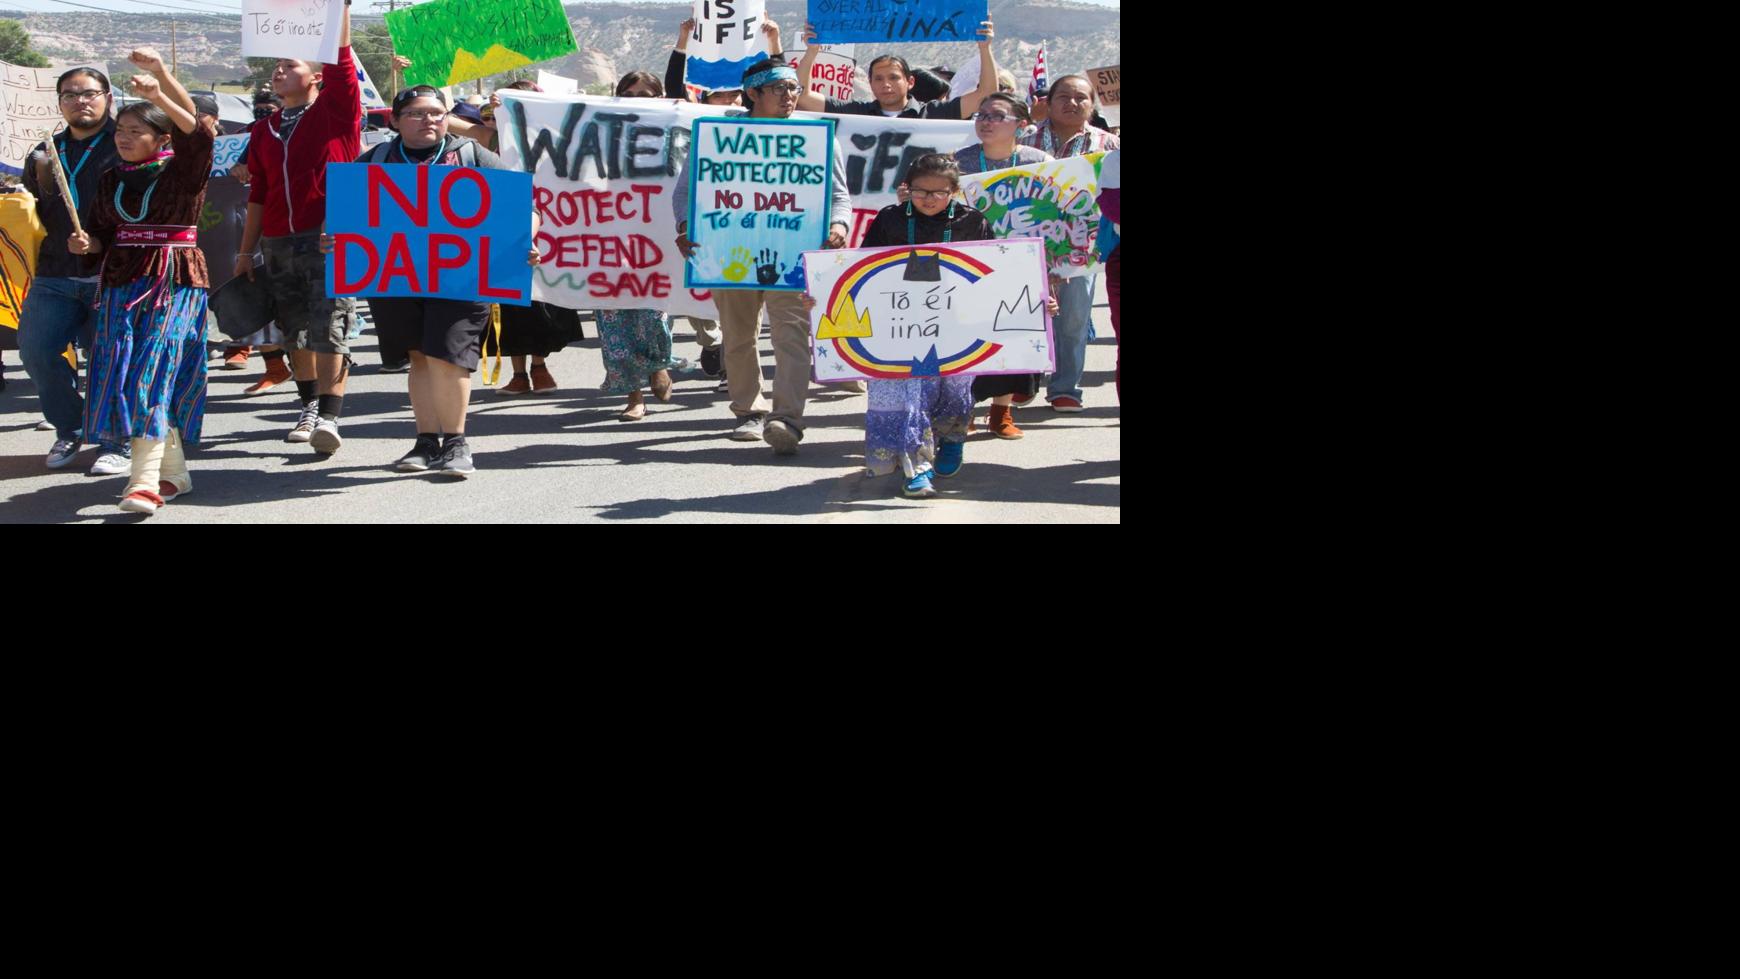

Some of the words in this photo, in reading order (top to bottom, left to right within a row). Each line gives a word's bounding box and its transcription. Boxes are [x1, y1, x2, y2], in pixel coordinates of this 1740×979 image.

[704, 0, 735, 19] IS
[713, 126, 807, 159] WATER
[698, 157, 825, 185] PROTECTORS
[367, 165, 492, 229] NO
[714, 189, 743, 210] NO
[754, 191, 805, 213] DAPL
[702, 211, 732, 230] Tó
[533, 232, 664, 270] DEFEND
[334, 233, 522, 299] DAPL
[587, 271, 672, 299] SAVE
[880, 291, 911, 310] Tó
[922, 285, 957, 310] éí
[891, 316, 939, 339] iiná
